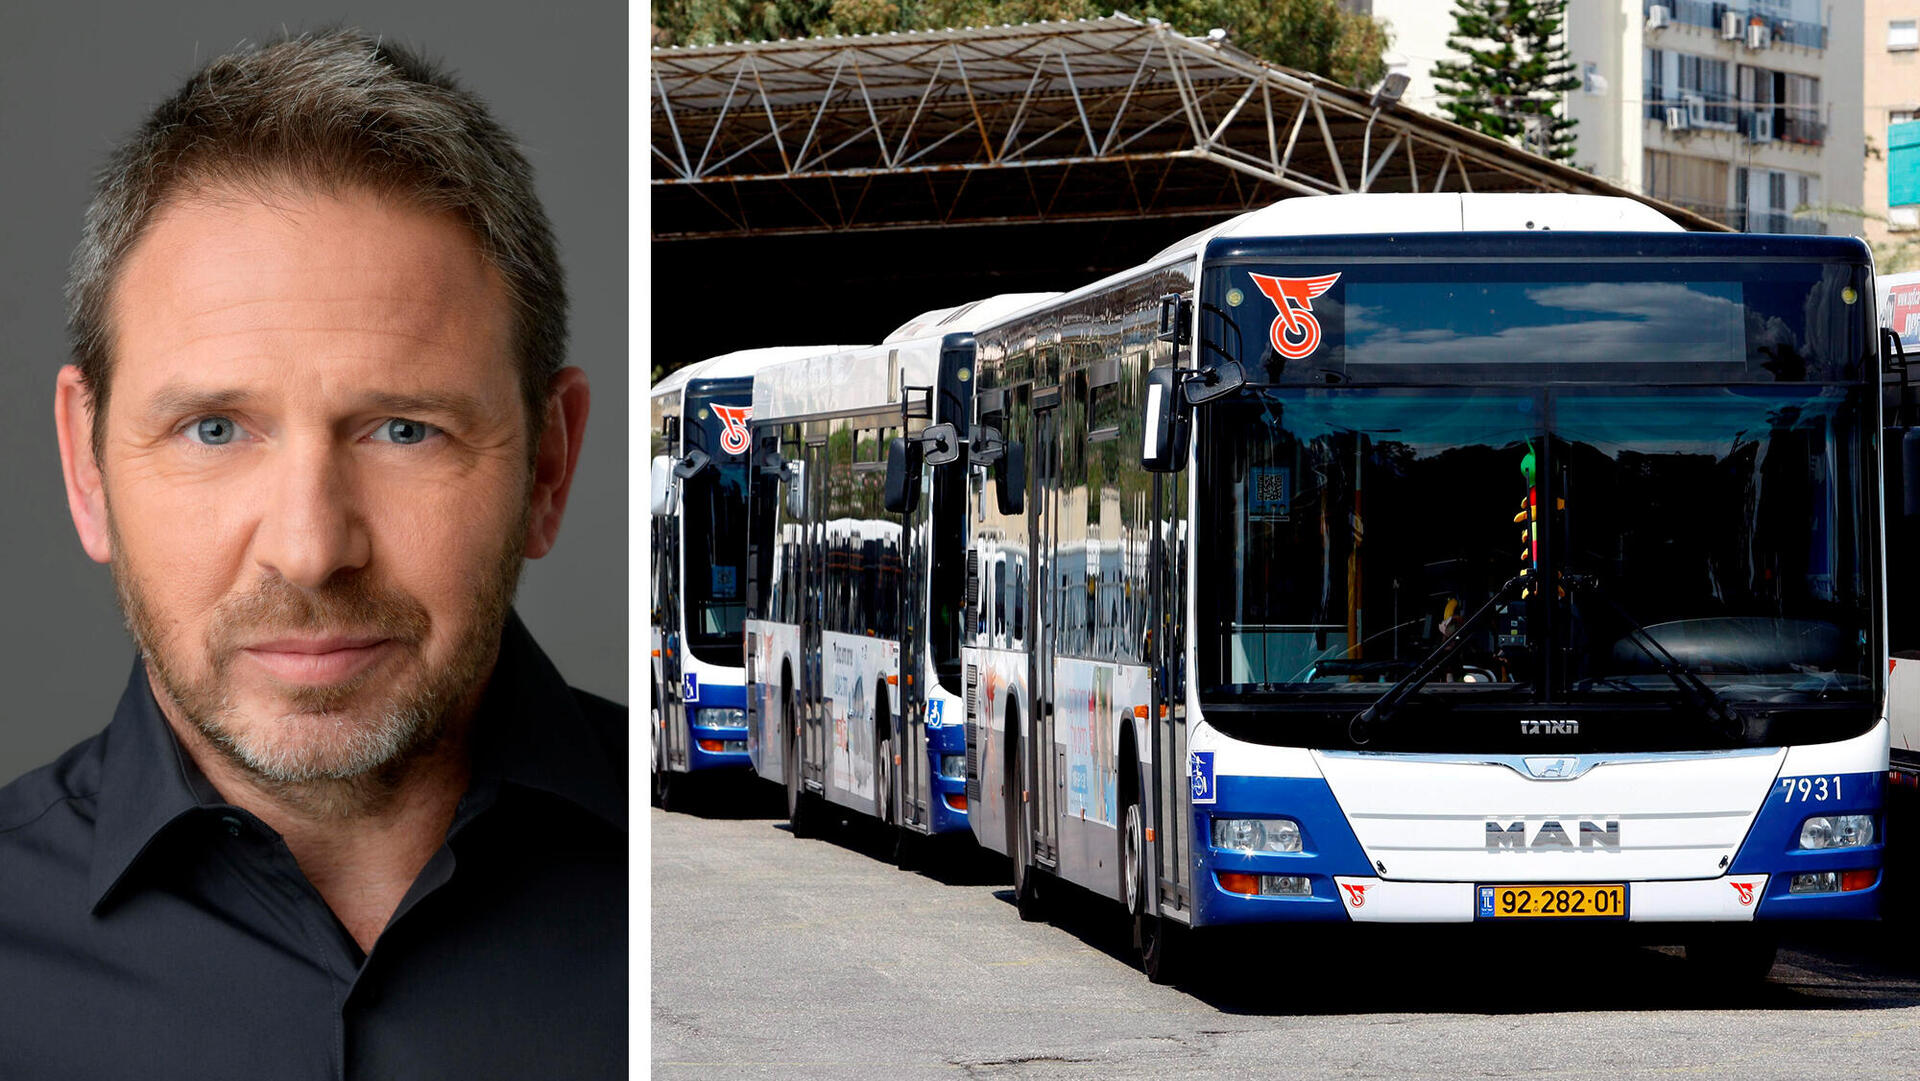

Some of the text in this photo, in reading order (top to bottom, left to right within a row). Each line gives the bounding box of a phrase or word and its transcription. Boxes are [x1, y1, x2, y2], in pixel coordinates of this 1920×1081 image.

[1520, 720, 1579, 735] הארגז
[1782, 776, 1841, 803] 7931
[1485, 821, 1621, 848] MAN
